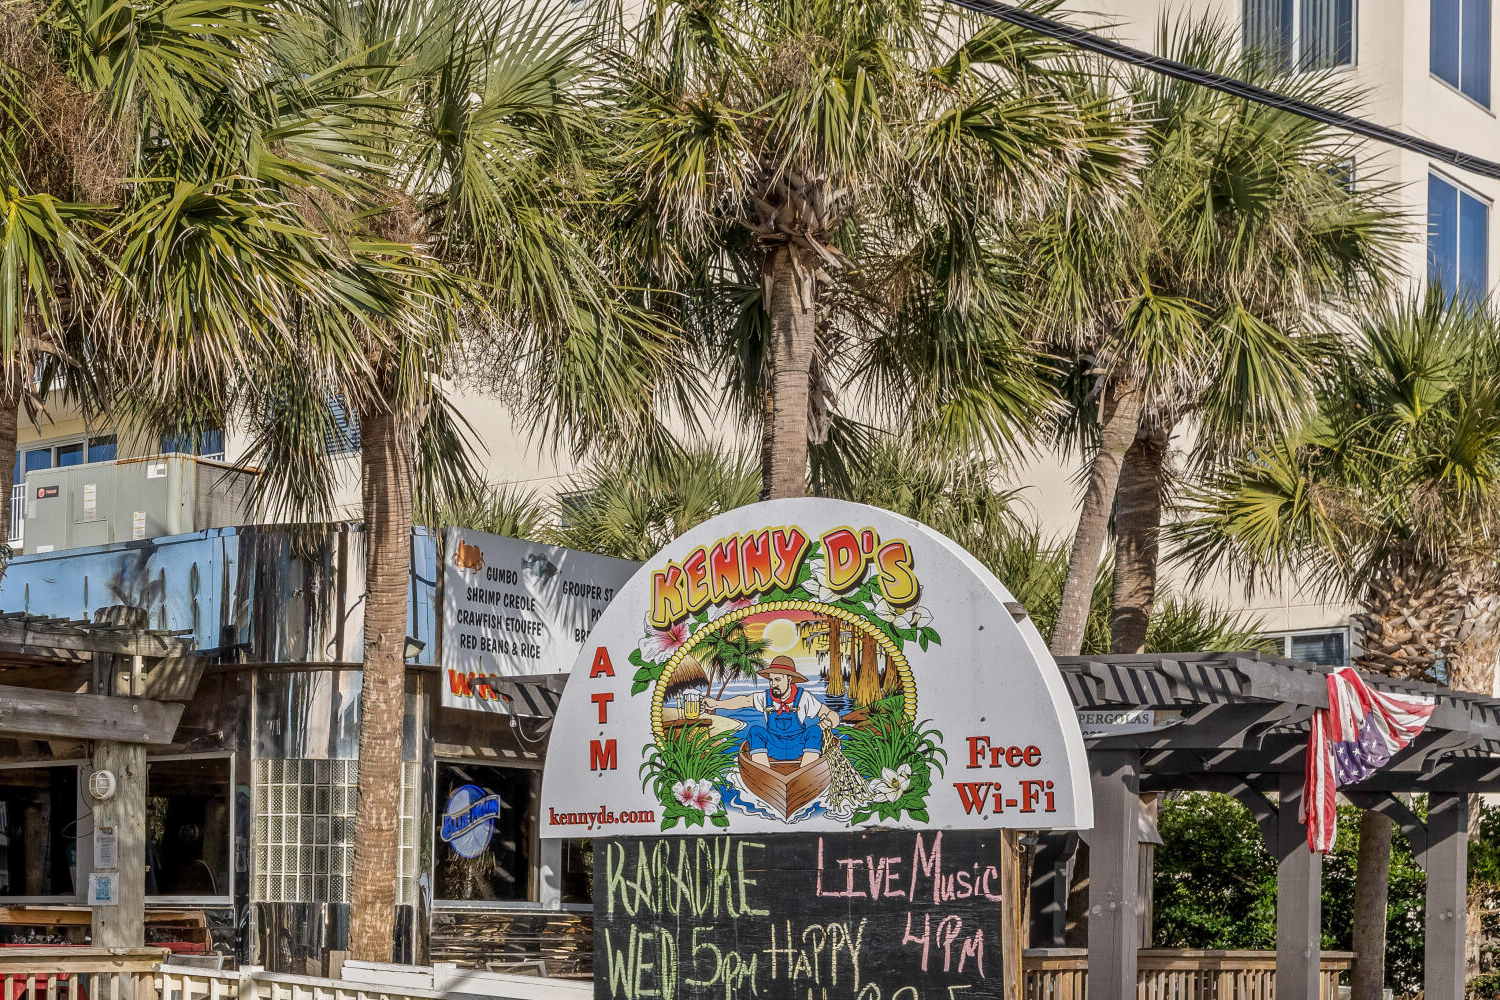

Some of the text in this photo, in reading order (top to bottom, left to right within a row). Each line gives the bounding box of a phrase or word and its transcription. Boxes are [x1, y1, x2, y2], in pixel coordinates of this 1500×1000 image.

[486, 566, 518, 586] GUMBO
[562, 580, 602, 601] GROUPER
[651, 525, 920, 631] KENNY D'S
[466, 586, 536, 612] SHRIMP CREOLE
[456, 609, 502, 630] CRAWFISH
[460, 633, 541, 660] RED BEANS & RICE
[589, 646, 617, 771] ATM
[1077, 713, 1149, 725] PERGOLAS
[966, 736, 1042, 769] Free
[953, 780, 1057, 815] Wi-Fi
[442, 798, 499, 839] BLUE MOON
[549, 806, 655, 830] kennyds.com
[606, 835, 770, 919] KARAOKE
[815, 830, 1003, 906] LIVE Music
[763, 917, 868, 993] HAPPY
